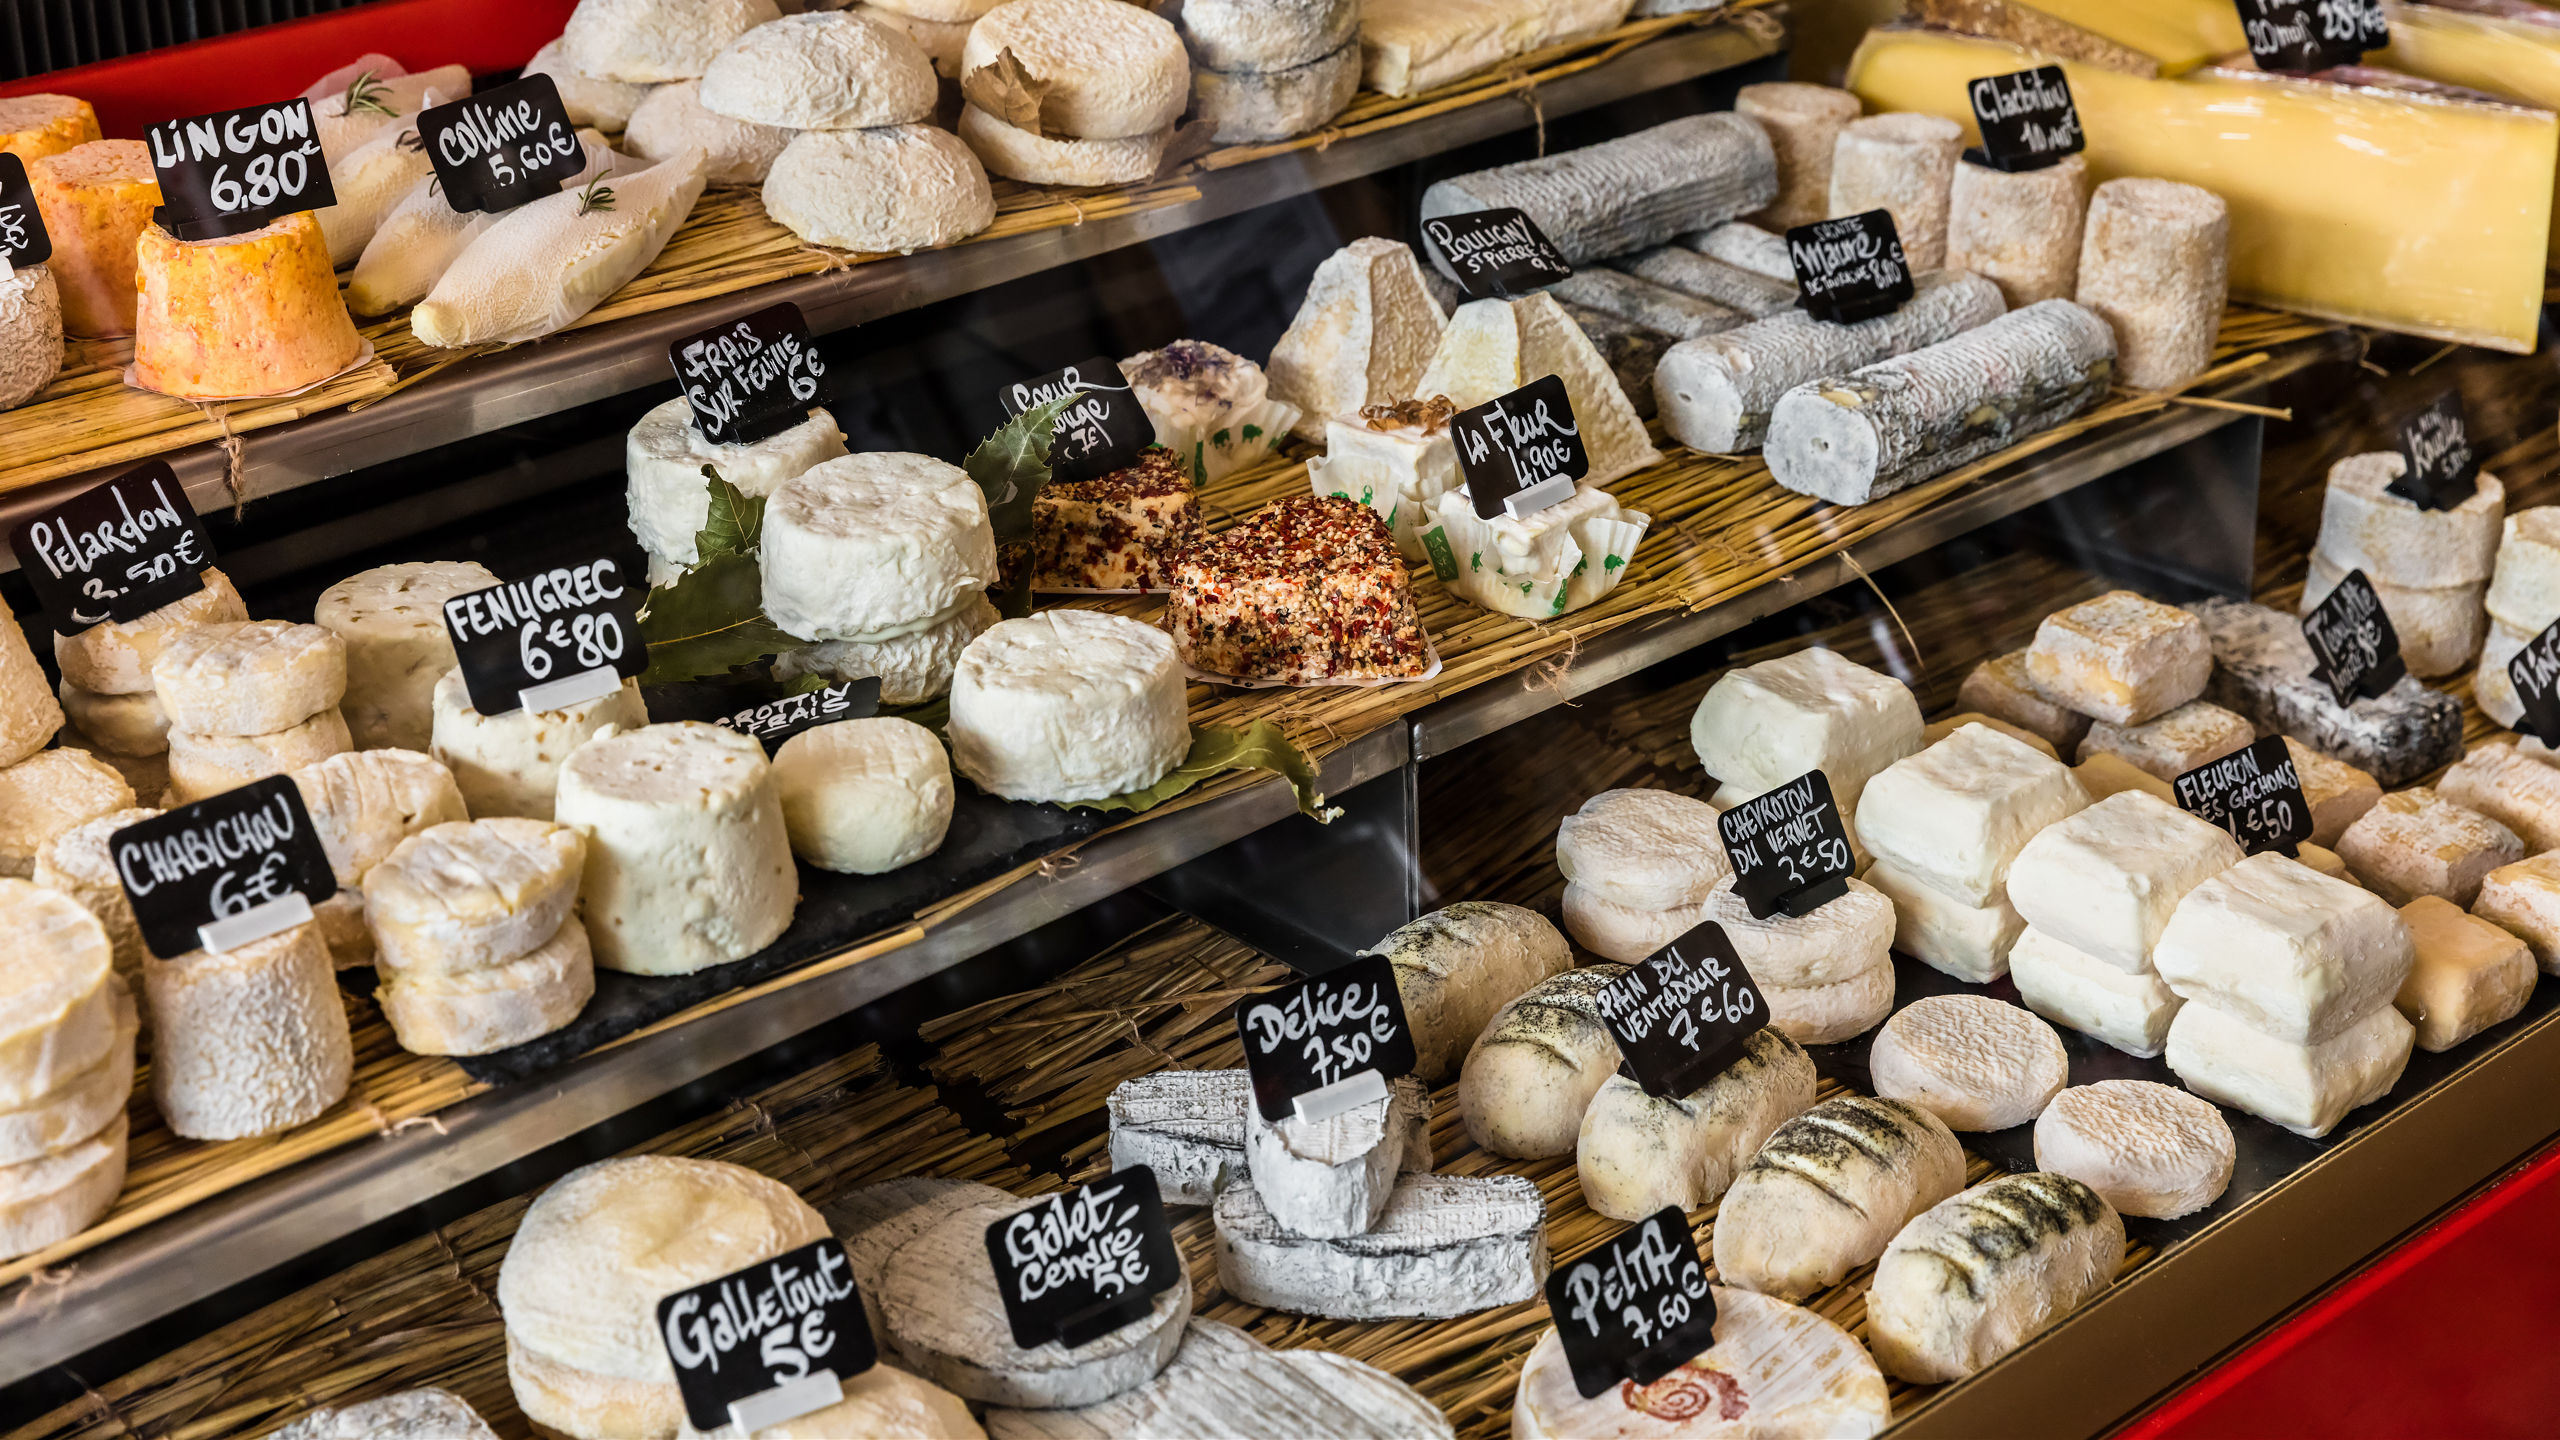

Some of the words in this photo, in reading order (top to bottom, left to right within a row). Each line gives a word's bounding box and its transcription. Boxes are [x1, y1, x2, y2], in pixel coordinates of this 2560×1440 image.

[151, 101, 308, 168] LiNGON
[440, 100, 541, 167] Colline
[488, 122, 575, 186] 5,60€
[210, 142, 320, 211] 6,80€
[1792, 231, 1882, 276] Maure
[682, 322, 762, 383] FRAiS
[689, 378, 744, 436] SUR
[1051, 398, 1113, 448] ouge
[1459, 426, 1490, 465] LA
[446, 559, 624, 642] FENUGREC
[520, 612, 623, 679] 6€80
[1723, 774, 1814, 843] CHEVROTON
[2177, 747, 2260, 808] FLEURON
[2229, 760, 2298, 809] GACHONS
[119, 792, 295, 897] CHABICHOU
[1731, 840, 1763, 875] DU
[1765, 802, 1827, 853] VERNET
[1246, 982, 1378, 1054] Délice
[1596, 970, 1648, 1021] PAiN
[1650, 946, 1690, 986] DU
[1616, 957, 1731, 1043] VENTADOUR
[1004, 1184, 1125, 1268] Galet
[1019, 1204, 1145, 1303] Cendré
[666, 1246, 853, 1375] Galletout
[760, 1309, 836, 1388] 5€
